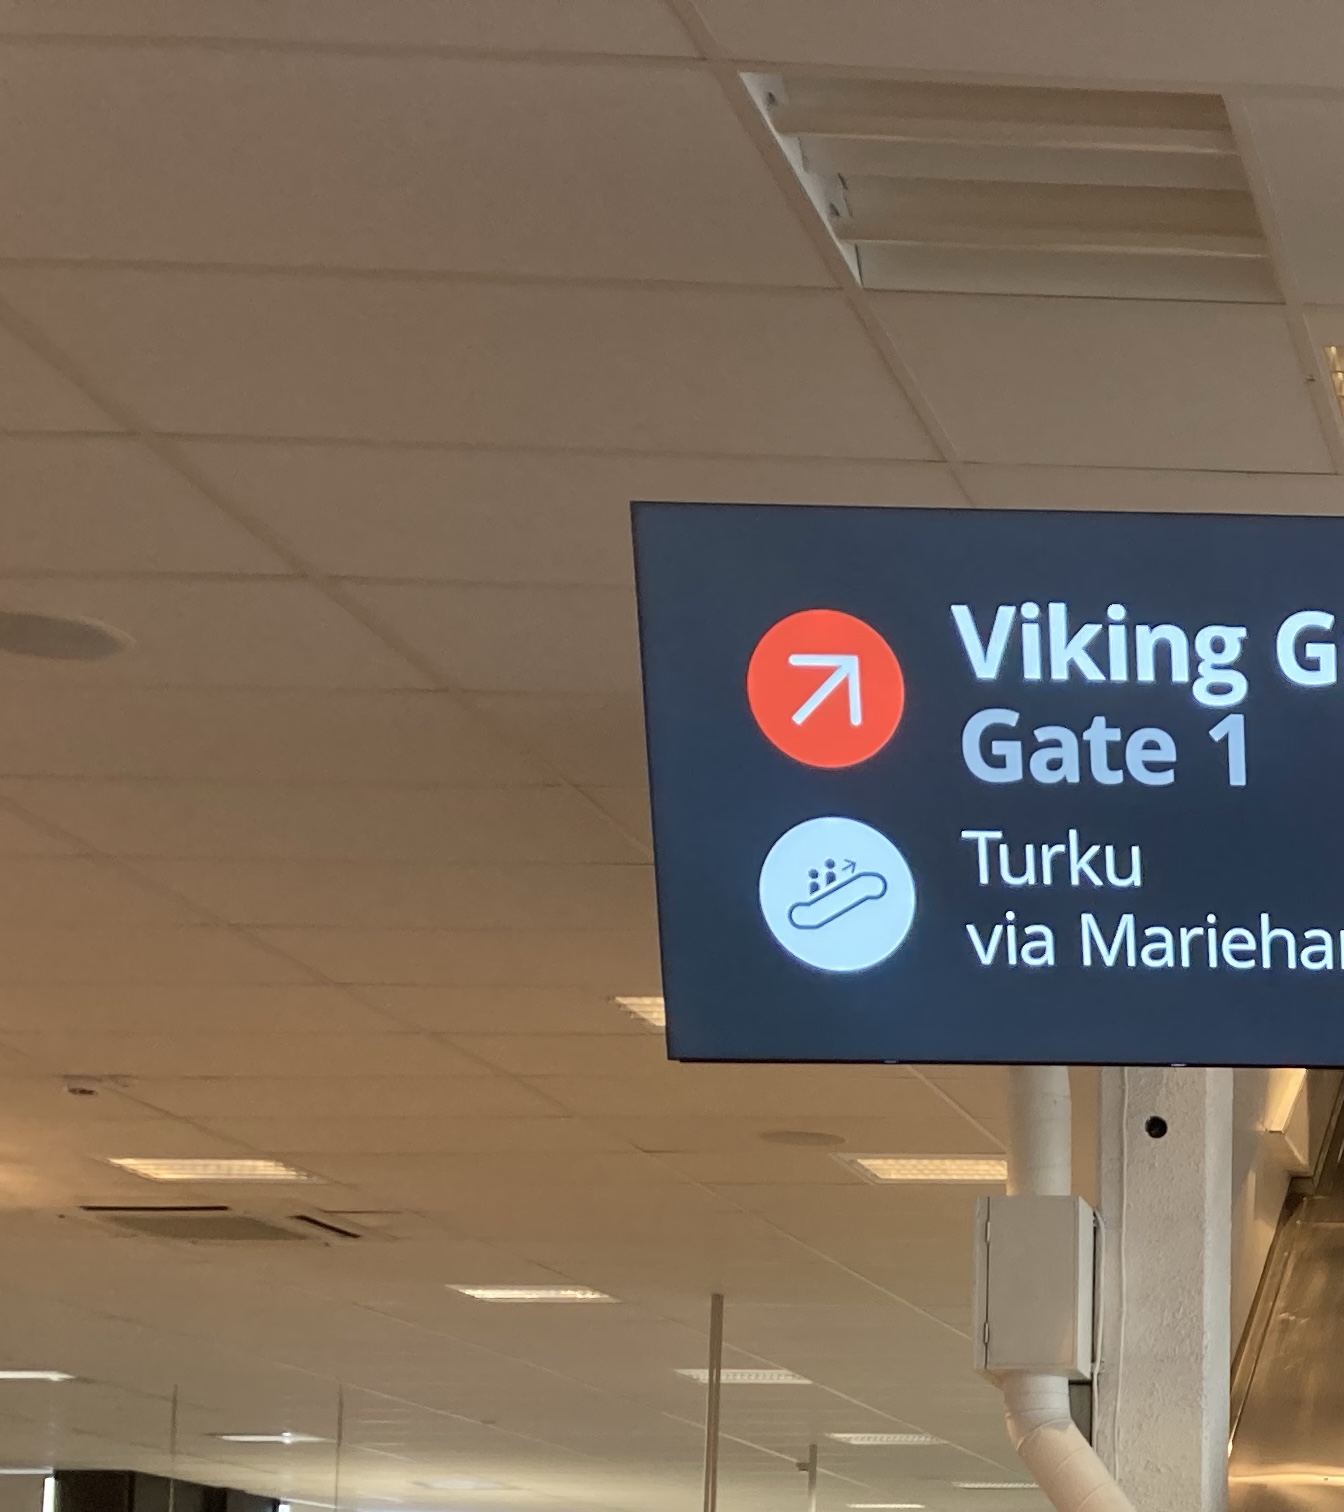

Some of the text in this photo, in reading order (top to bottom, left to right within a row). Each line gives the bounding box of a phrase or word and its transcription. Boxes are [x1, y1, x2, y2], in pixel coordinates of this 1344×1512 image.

[950, 601, 1248, 706] Viking
[961, 708, 1247, 787] Gate 1
[961, 828, 1142, 888] Turku
[965, 910, 1055, 967] via
